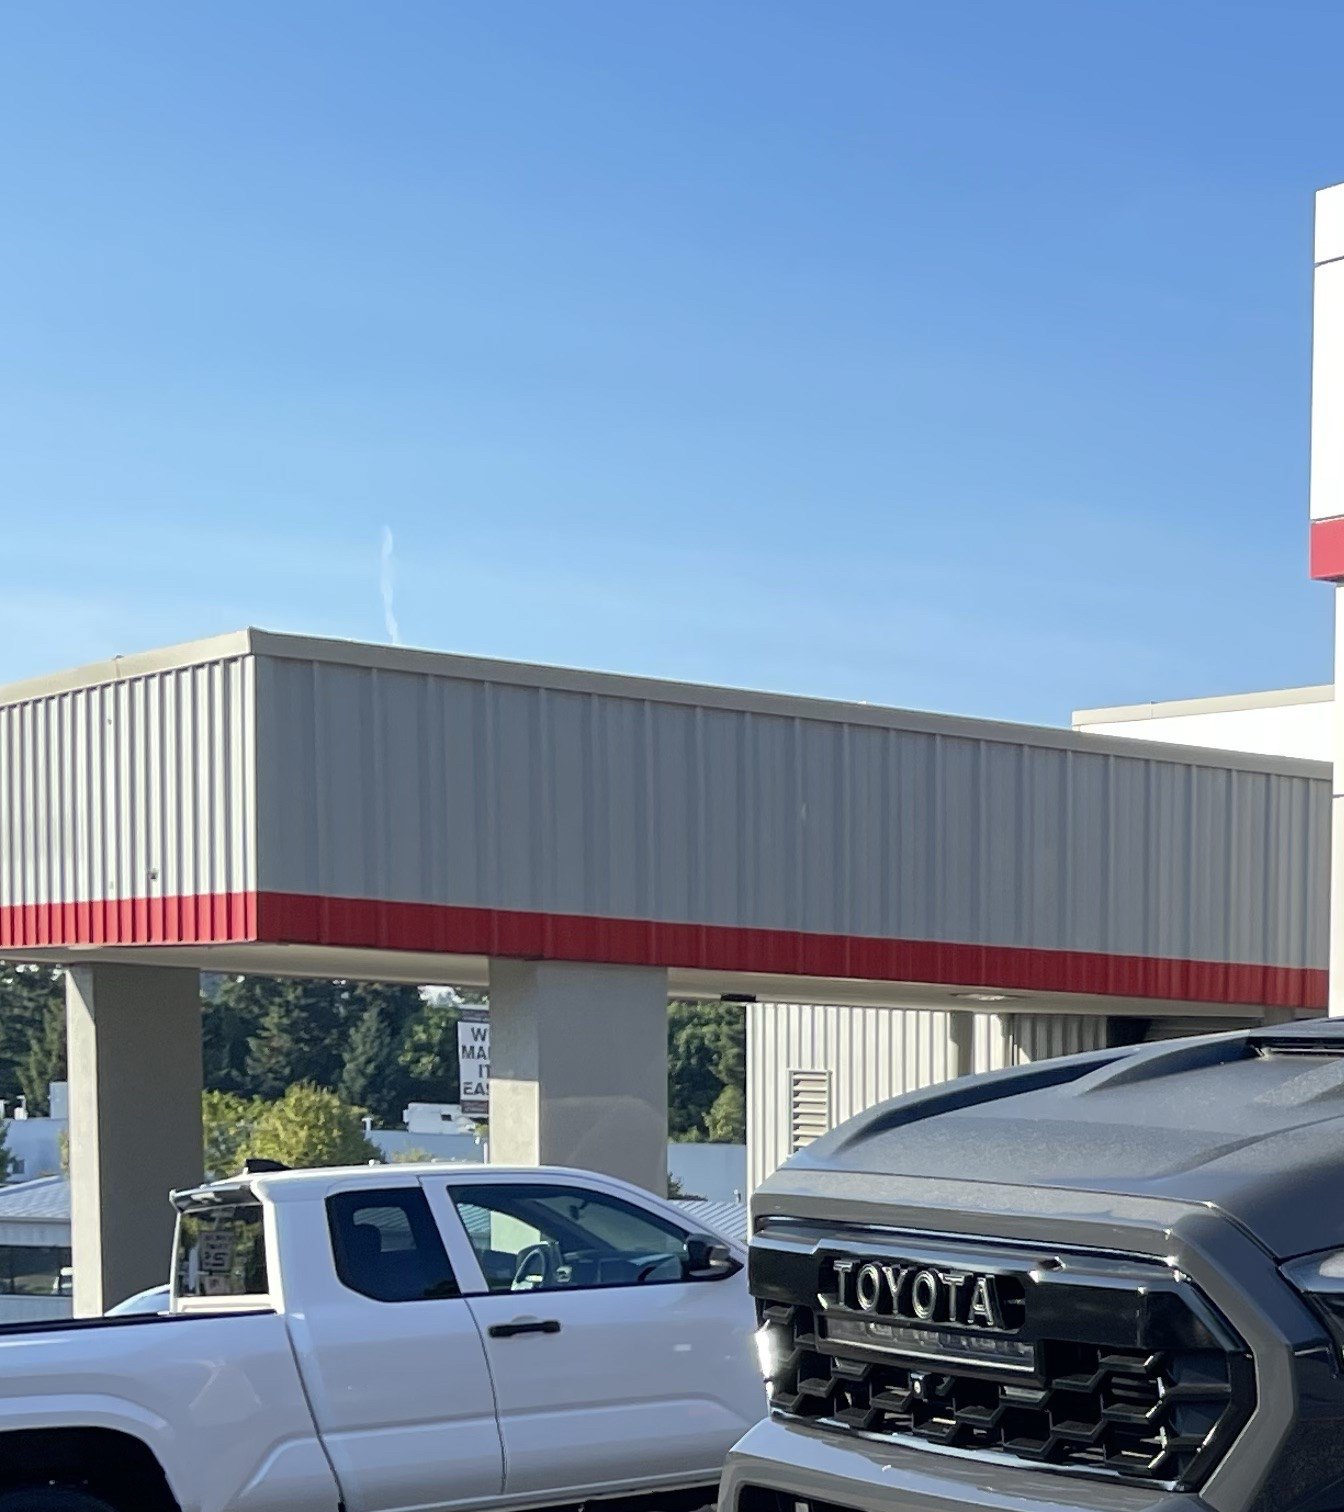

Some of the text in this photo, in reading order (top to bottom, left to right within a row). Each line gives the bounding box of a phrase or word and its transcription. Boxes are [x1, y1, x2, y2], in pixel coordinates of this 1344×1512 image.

[471, 1027, 488, 1042] W
[461, 1045, 490, 1060] MA
[463, 1081, 490, 1096] EA
[832, 1259, 997, 1327] TOYOTA
